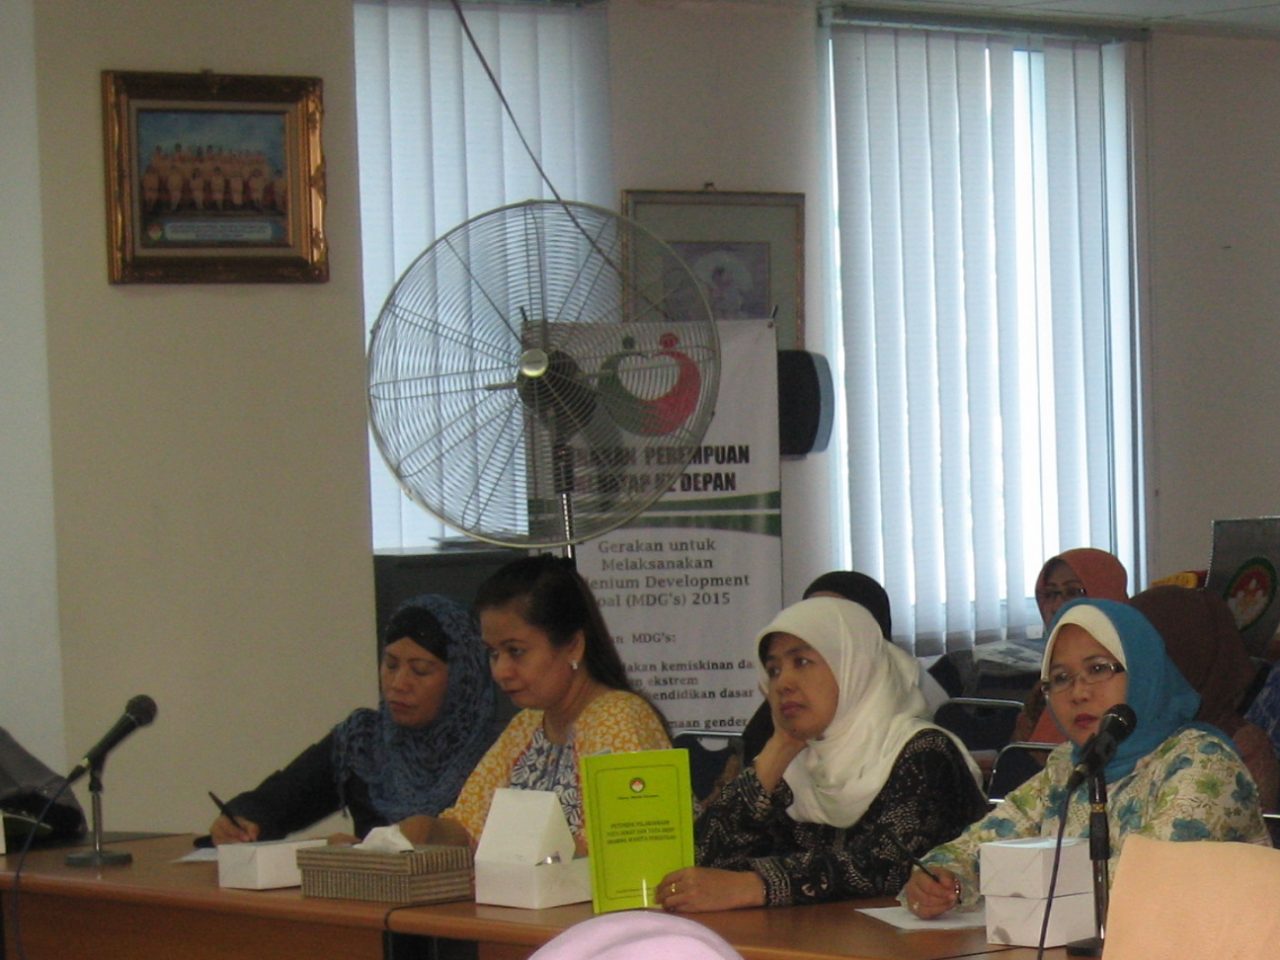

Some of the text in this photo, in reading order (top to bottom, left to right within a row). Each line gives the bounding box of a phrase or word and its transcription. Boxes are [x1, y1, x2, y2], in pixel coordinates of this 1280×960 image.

[645, 445, 750, 465] PEREMPUAN
[681, 472, 736, 492] DEPAN
[597, 538, 716, 554] Gerakan untuk
[601, 557, 713, 571] Melaksanakan
[645, 574, 749, 590] Development
[626, 592, 687, 608] (MDG's)
[692, 591, 731, 606] 2015
[661, 659, 733, 672] kemiskinan
[648, 675, 699, 687] ekstrem
[720, 687, 754, 699] dasar
[704, 716, 747, 730] gender
